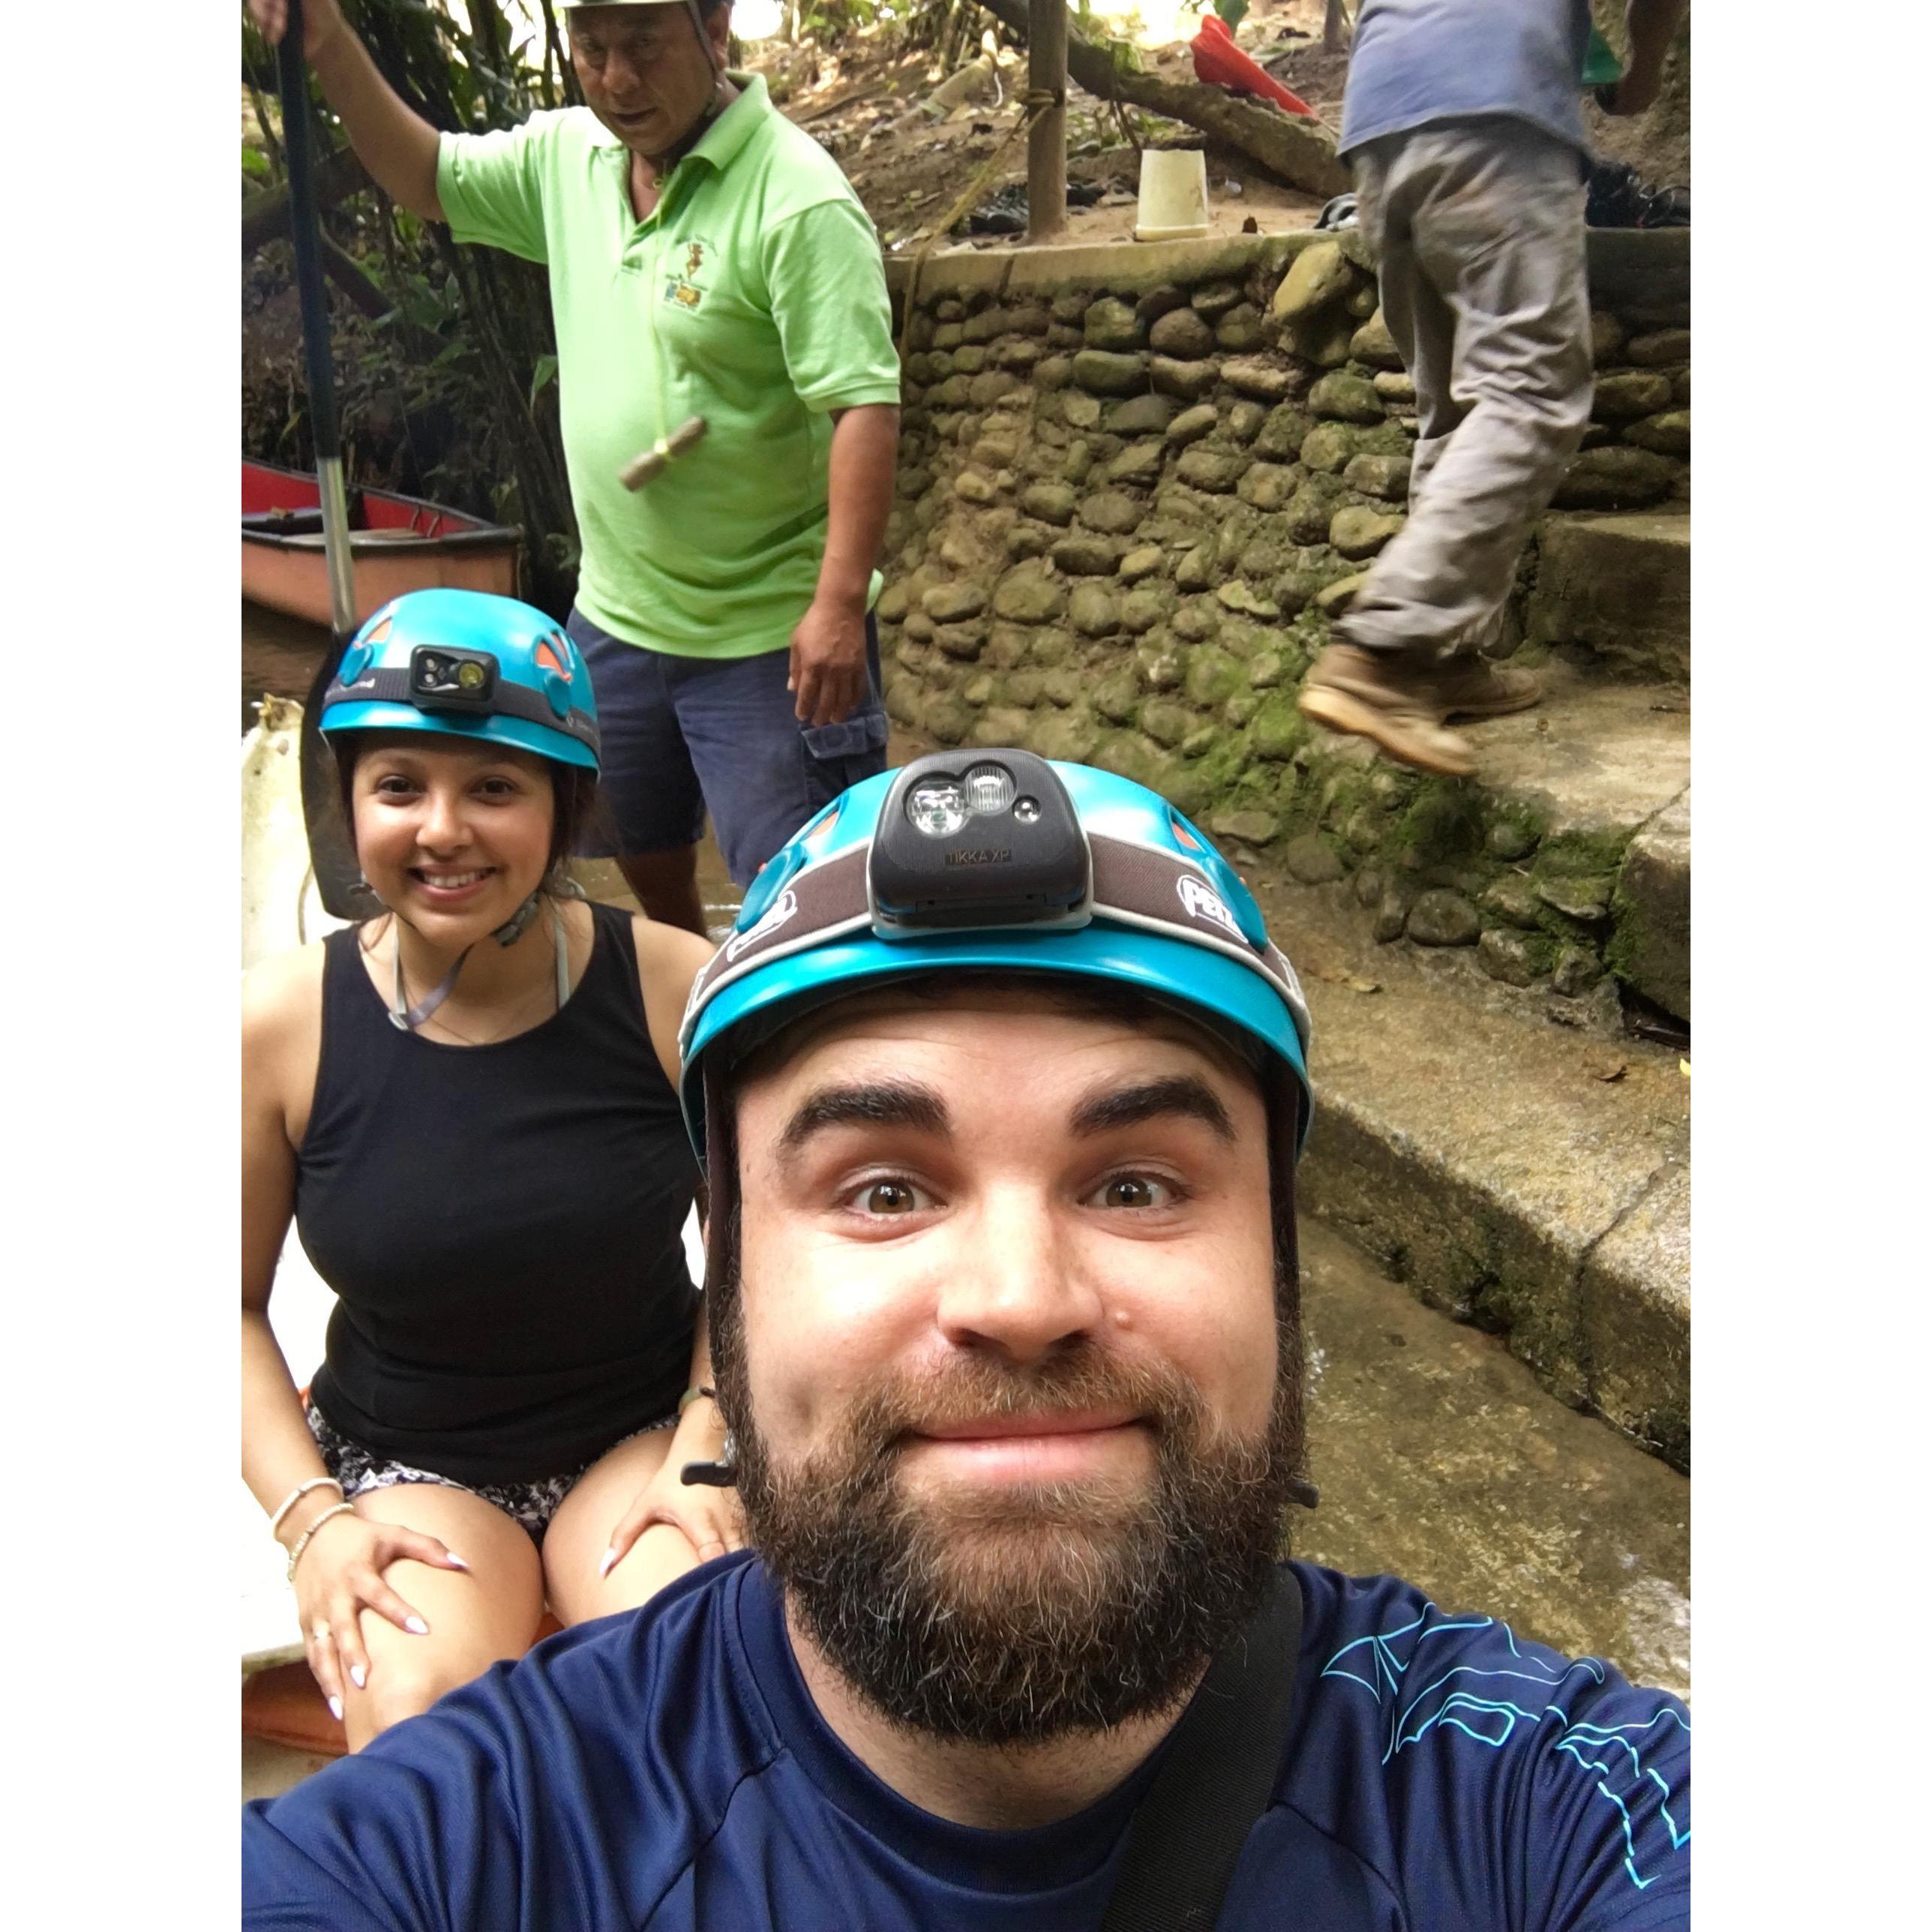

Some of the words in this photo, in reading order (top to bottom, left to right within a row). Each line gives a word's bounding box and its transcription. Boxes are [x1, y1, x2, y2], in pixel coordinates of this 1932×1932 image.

[947, 850, 987, 864] TIKKA
[990, 849, 1010, 862] XP
[1181, 878, 1243, 937] PETZ
